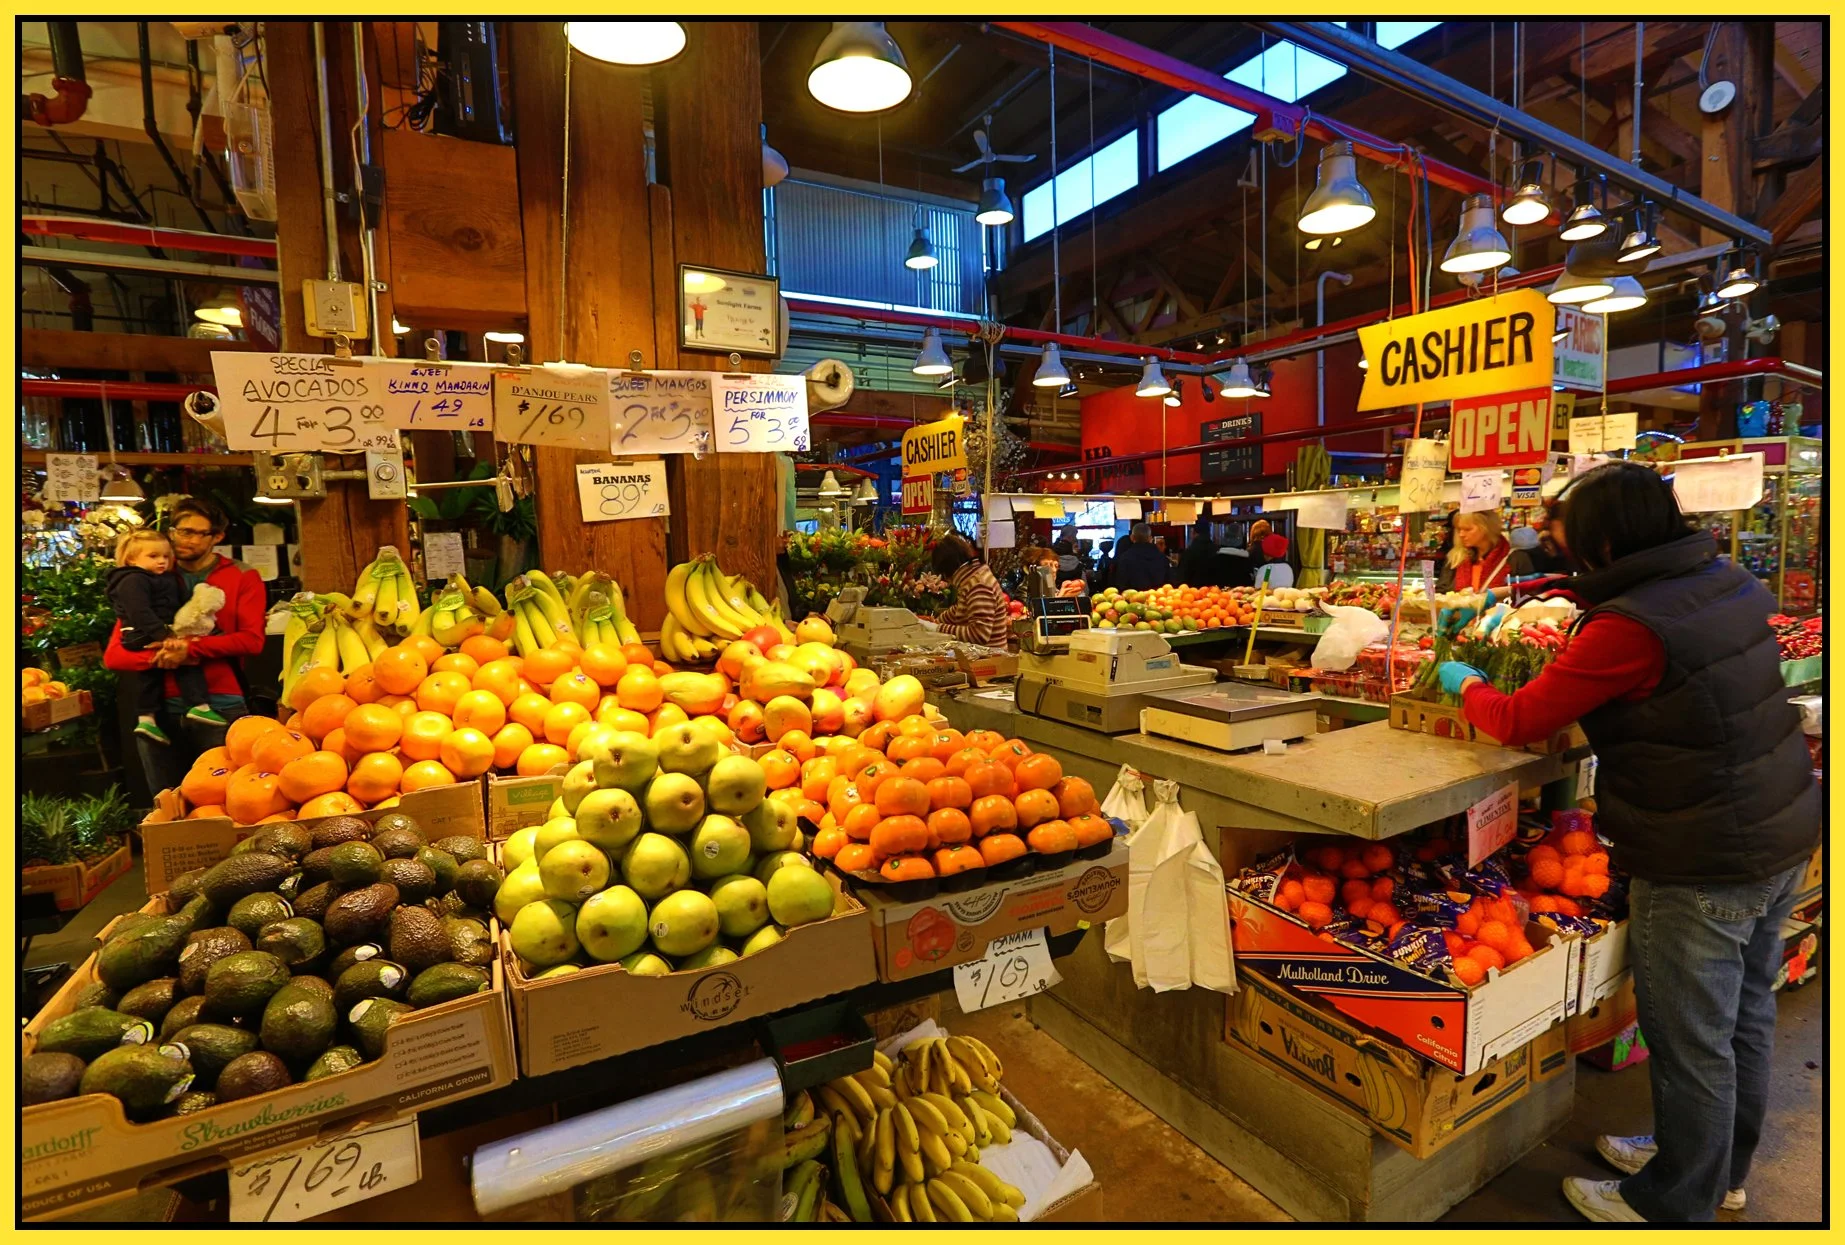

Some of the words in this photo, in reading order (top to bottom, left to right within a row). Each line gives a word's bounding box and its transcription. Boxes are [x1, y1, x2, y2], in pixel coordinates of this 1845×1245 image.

[1381, 312, 1534, 386] CASHIER
[243, 377, 369, 398] AVOCADOS
[436, 380, 491, 391] MANDARIN
[512, 385, 560, 399] D'ANJOU
[564, 392, 598, 403] PEARS
[610, 376, 651, 393] SWEET
[655, 378, 707, 392] MANGOS
[725, 391, 798, 408] PERSIMMON
[251, 405, 296, 447] 4
[469, 418, 484, 427] LB
[621, 404, 648, 445] 2
[751, 411, 766, 420] FOR
[1222, 417, 1252, 429] DRINKS
[729, 416, 749, 445] 5
[1454, 399, 1548, 458] OPEN
[906, 430, 957, 465] CASHIER
[593, 475, 651, 485] BANANAS
[903, 480, 932, 508] OPEN
[652, 504, 665, 513] LB
[1067, 878, 1121, 900] HOUWELING'S
[992, 930, 1033, 950] BANANA
[1392, 934, 1428, 958] SUNKIST
[1277, 963, 1344, 982] Mulholland
[1346, 966, 1389, 985] Drive
[680, 985, 750, 1013] windset
[1279, 1025, 1337, 1084] BONITA
[1416, 1034, 1458, 1058] California
[1433, 1051, 1458, 1067] Citrus
[399, 1082, 454, 1103] CALIFORNIA
[455, 1072, 488, 1086] GROWN
[181, 1091, 349, 1150] Strawberries
[67, 1188, 83, 1198] OF
[86, 1181, 112, 1194] USA
